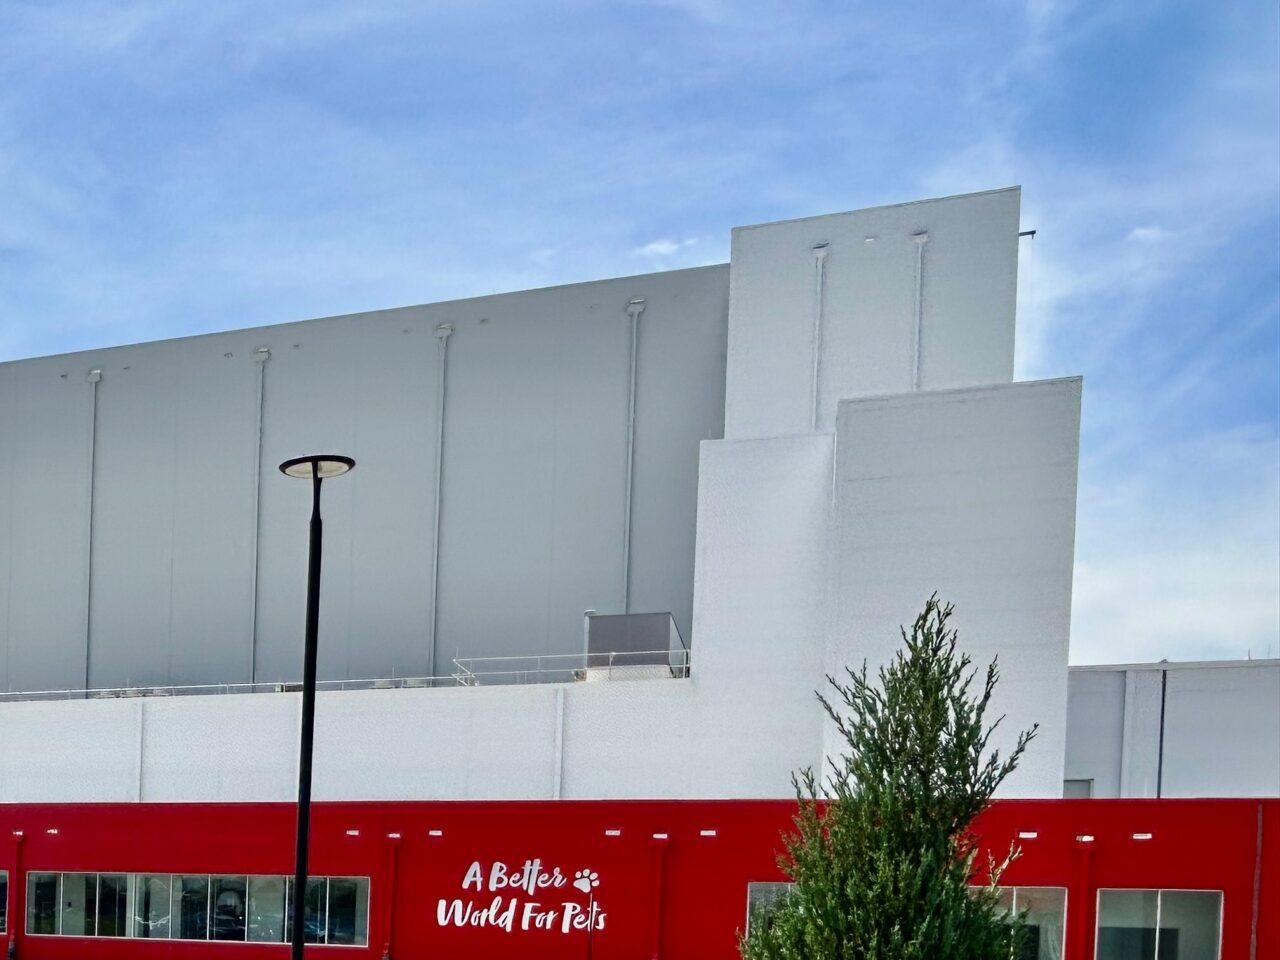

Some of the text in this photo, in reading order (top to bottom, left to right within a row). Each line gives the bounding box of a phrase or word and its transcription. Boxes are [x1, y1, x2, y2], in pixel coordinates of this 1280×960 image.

[462, 858, 567, 896] A Better
[436, 896, 607, 934] World For Pets
